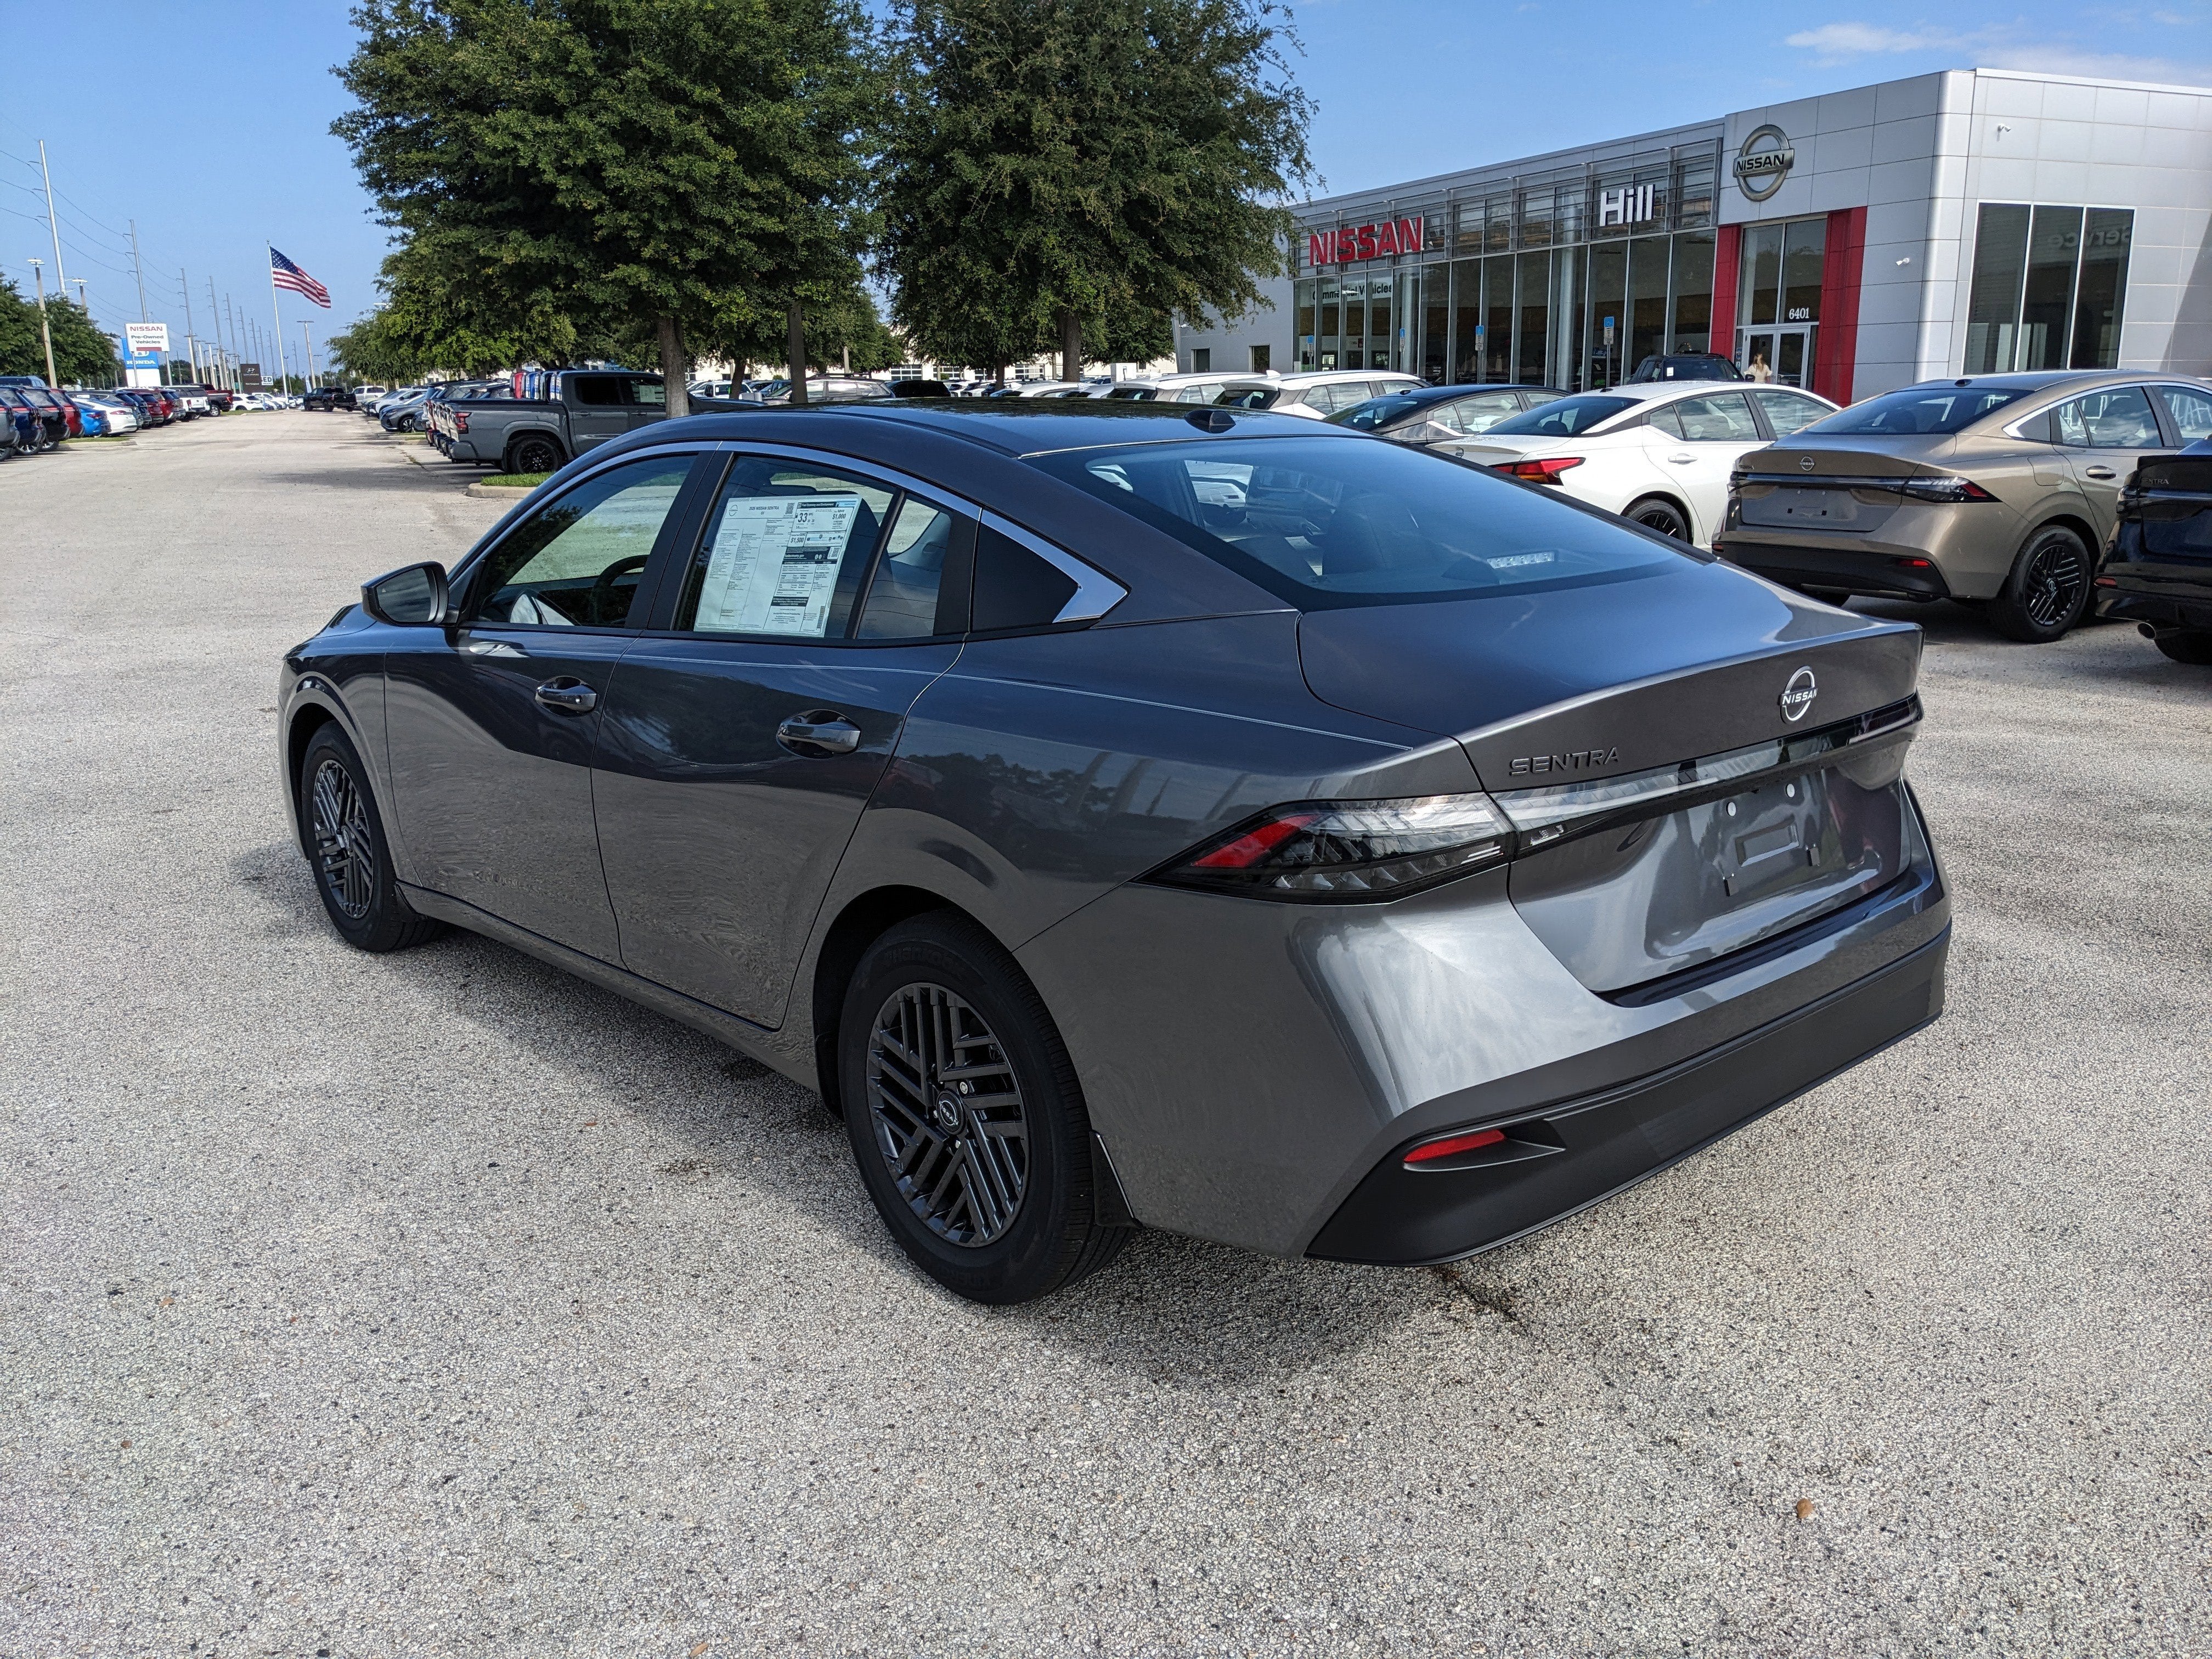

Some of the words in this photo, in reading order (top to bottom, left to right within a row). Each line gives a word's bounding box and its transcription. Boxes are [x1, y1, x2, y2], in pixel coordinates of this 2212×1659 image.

[1736, 154, 1785, 172] NISSAN
[1600, 184, 1656, 227] Hill
[1310, 217, 1424, 266] NISSAN
[1789, 308, 1809, 319] 6401
[798, 512, 808, 523] 33
[1782, 689, 1818, 704] NISSAN
[1509, 747, 1618, 776] SENTRA
